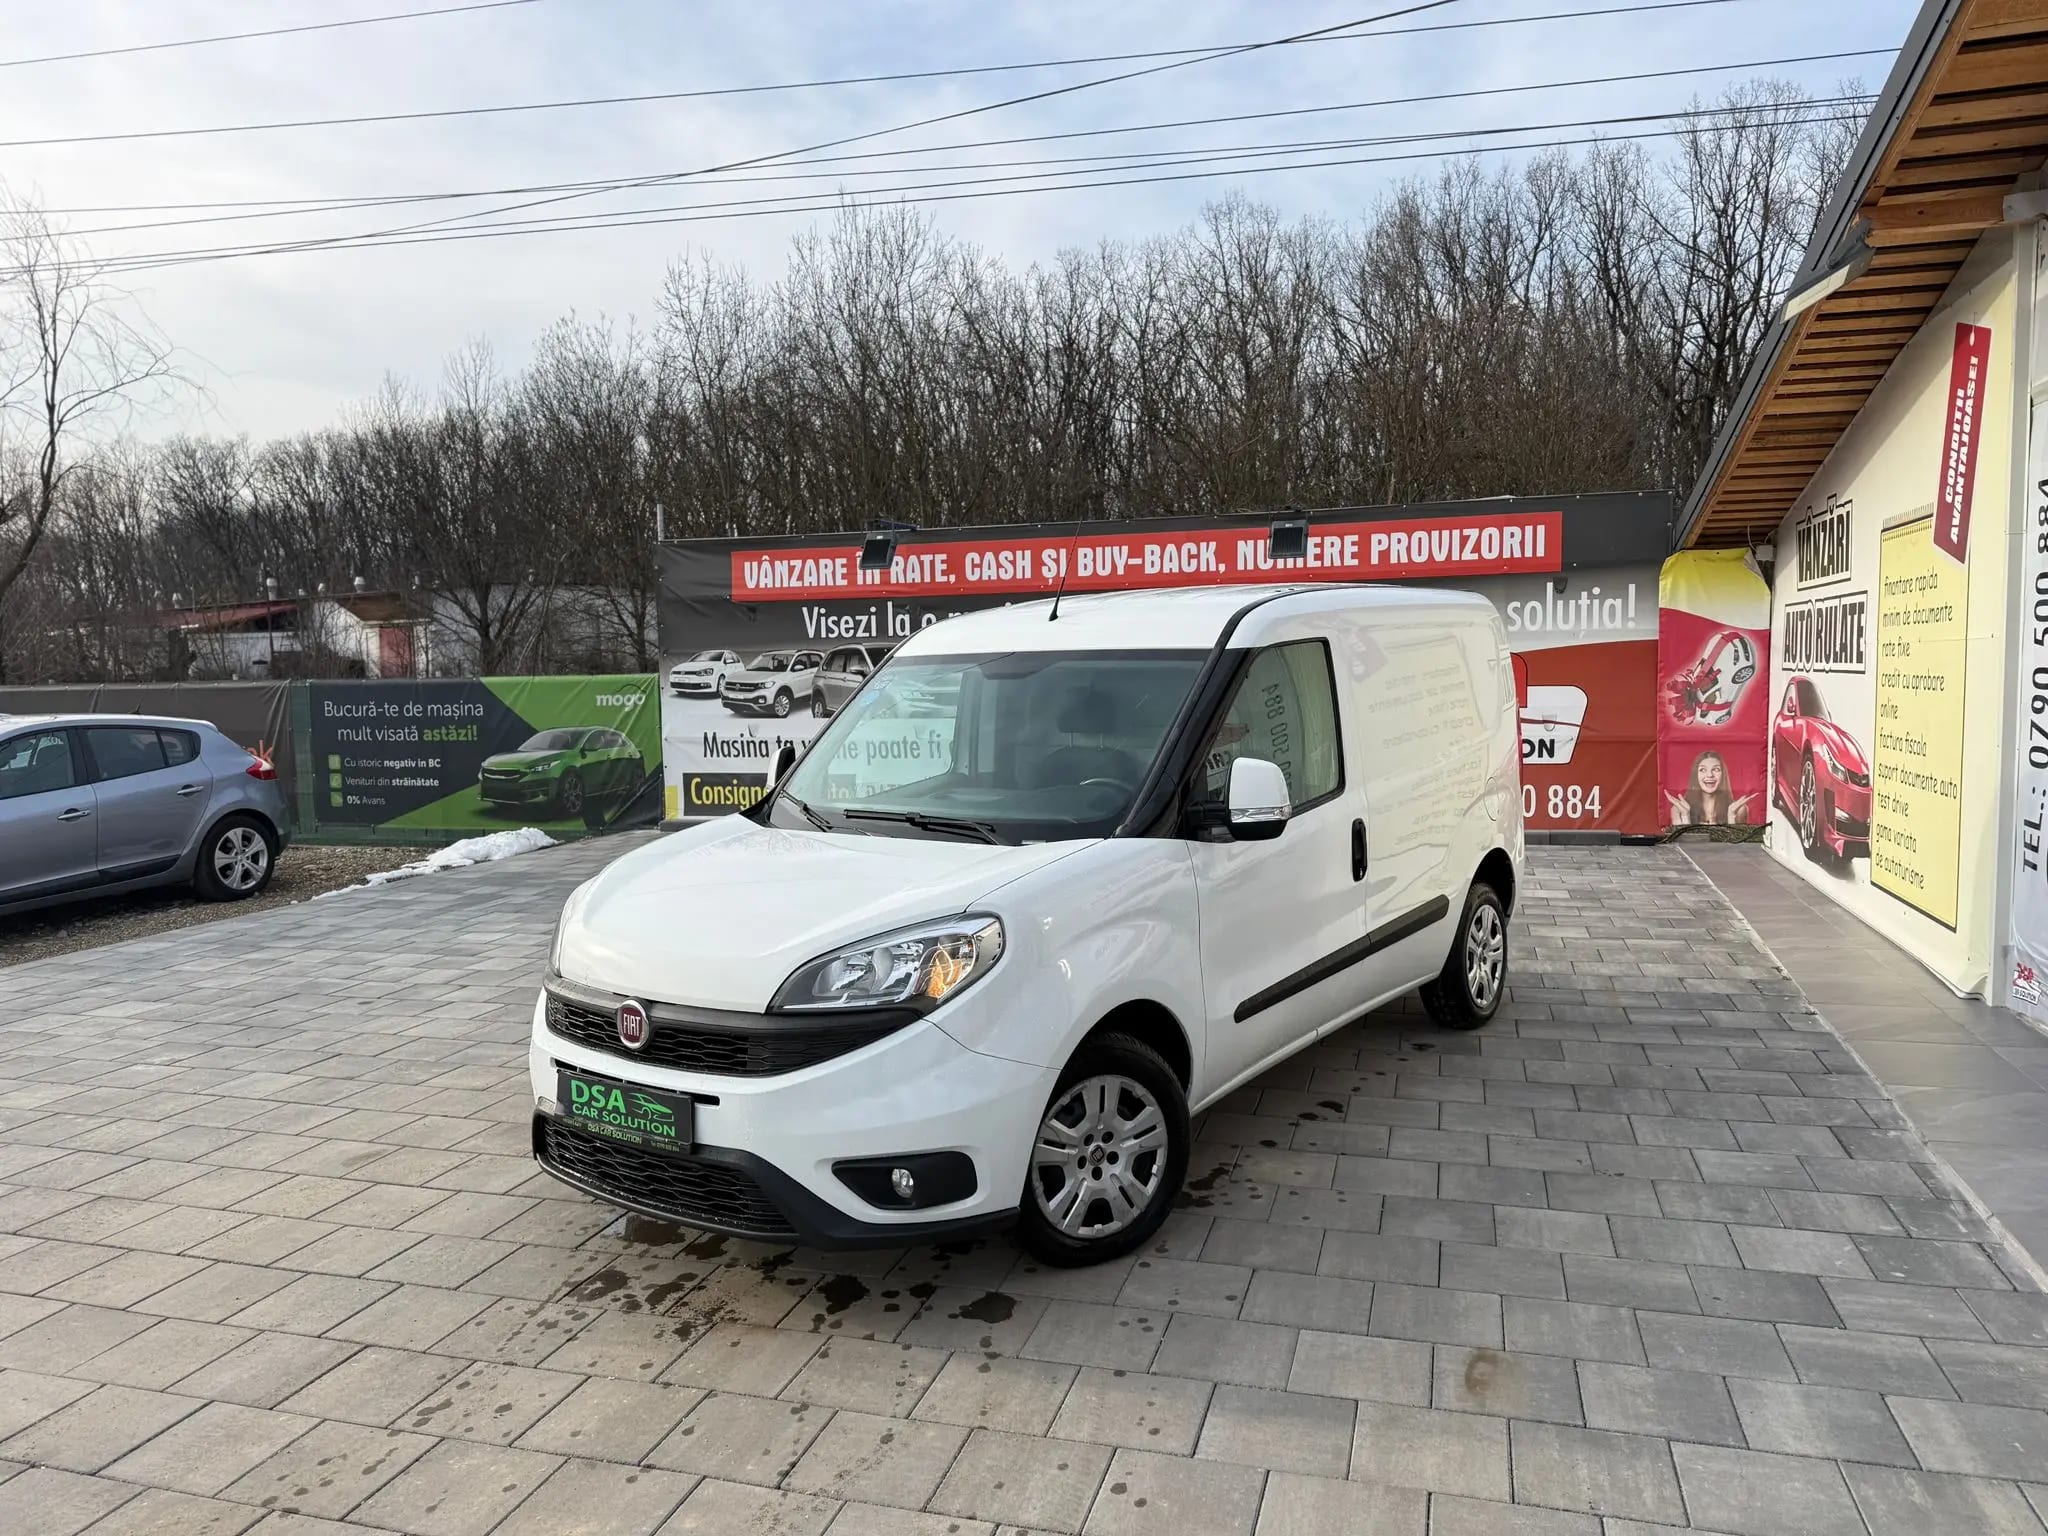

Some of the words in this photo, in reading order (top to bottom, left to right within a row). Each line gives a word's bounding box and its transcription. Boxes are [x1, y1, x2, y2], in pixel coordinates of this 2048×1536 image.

[744, 555, 848, 589] VÂNZARE
[890, 553, 956, 585] RATE,
[965, 550, 1031, 581] CASH
[1077, 542, 1226, 577] BUY-BACK,
[1237, 535, 1359, 570] NUERE
[1370, 525, 1546, 565] PROVIZORII
[802, 606, 877, 639] Visezi
[887, 601, 911, 637] la
[1902, 604, 1911, 625] de
[1913, 601, 1953, 624] documente
[324, 700, 399, 717] Bucură-te
[403, 701, 423, 717] de
[427, 700, 484, 720] mașina
[596, 694, 647, 711] mogo
[338, 725, 372, 742] mult
[375, 725, 418, 742] visată
[423, 725, 478, 742] astăzi!
[866, 735, 920, 765] poate
[344, 758, 356, 767] Cu
[357, 758, 382, 768] istoric
[384, 758, 416, 770] negativ
[428, 758, 441, 768] BC
[345, 776, 376, 787] Venituri
[377, 776, 390, 787] din
[347, 795, 361, 805] 0%
[362, 795, 386, 806] Avans
[1548, 785, 1601, 818] 884
[623, 1013, 641, 1037] FIAT
[571, 1079, 626, 1113] DSA
[572, 1103, 598, 1119] CAR
[602, 1111, 676, 1137] SOLUTION
[600, 1125, 611, 1136] CAR
[612, 1129, 642, 1145] SOLUTION
